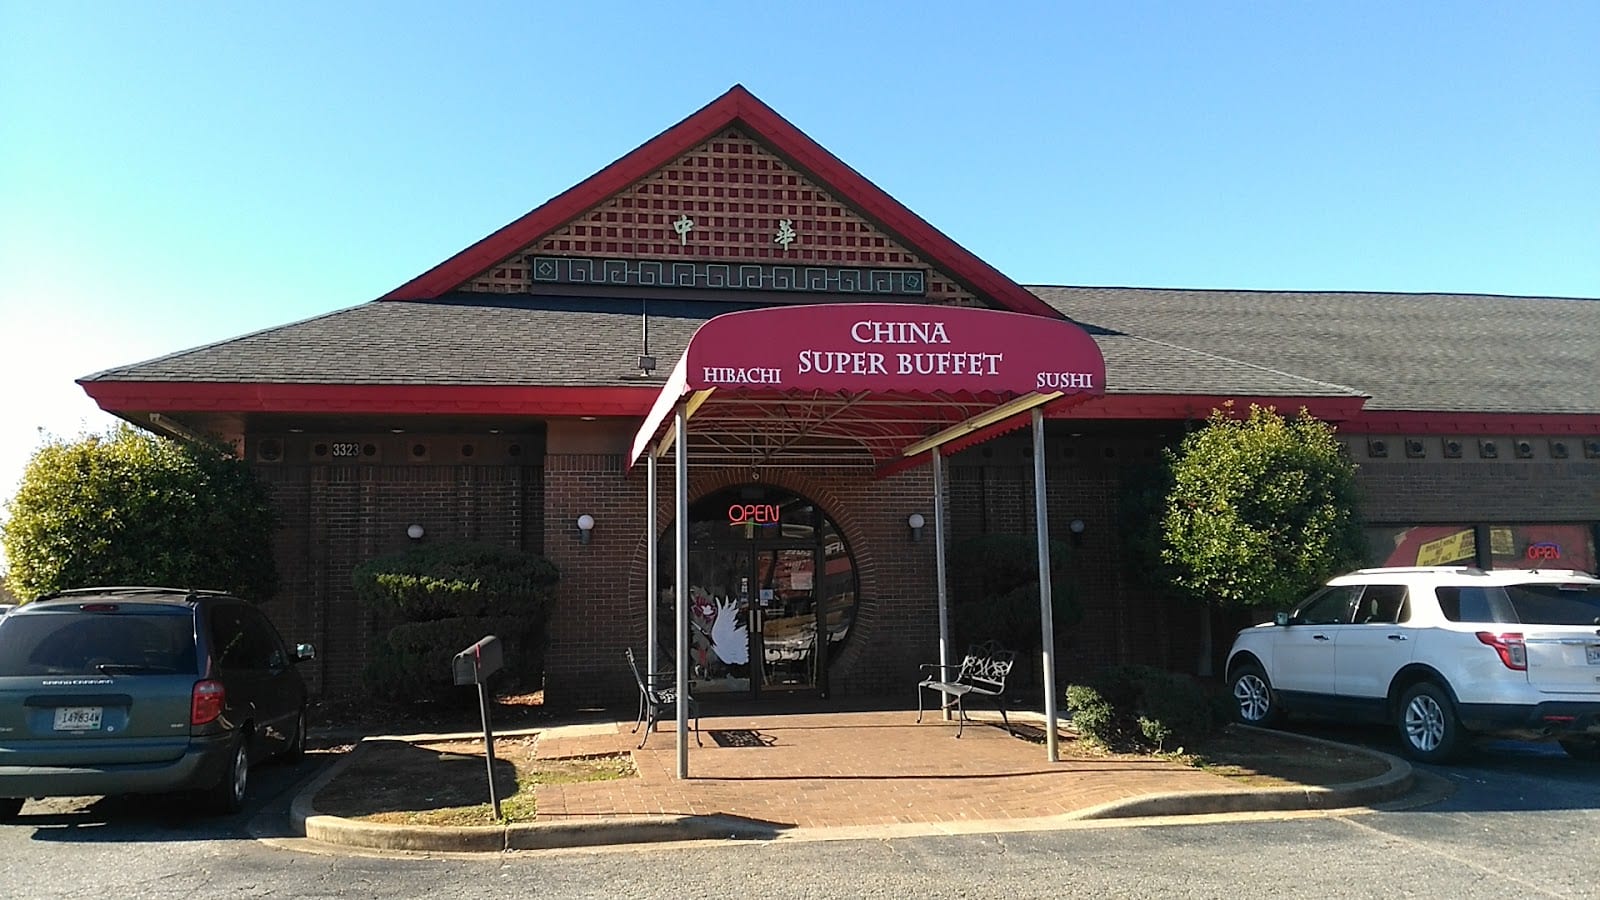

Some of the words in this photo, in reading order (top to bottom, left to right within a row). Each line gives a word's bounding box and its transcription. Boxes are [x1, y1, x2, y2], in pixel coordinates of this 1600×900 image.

[673, 214, 694, 246] 中
[774, 218, 797, 251] 華
[850, 320, 951, 344] CHINA
[798, 350, 889, 376] SUPER
[896, 352, 1003, 376] BUFFET
[702, 366, 783, 385] HIBACHI
[1036, 371, 1094, 389] SUSHI
[332, 443, 360, 456] 3323
[728, 504, 780, 522] OPEN
[1527, 545, 1560, 560] OPEN
